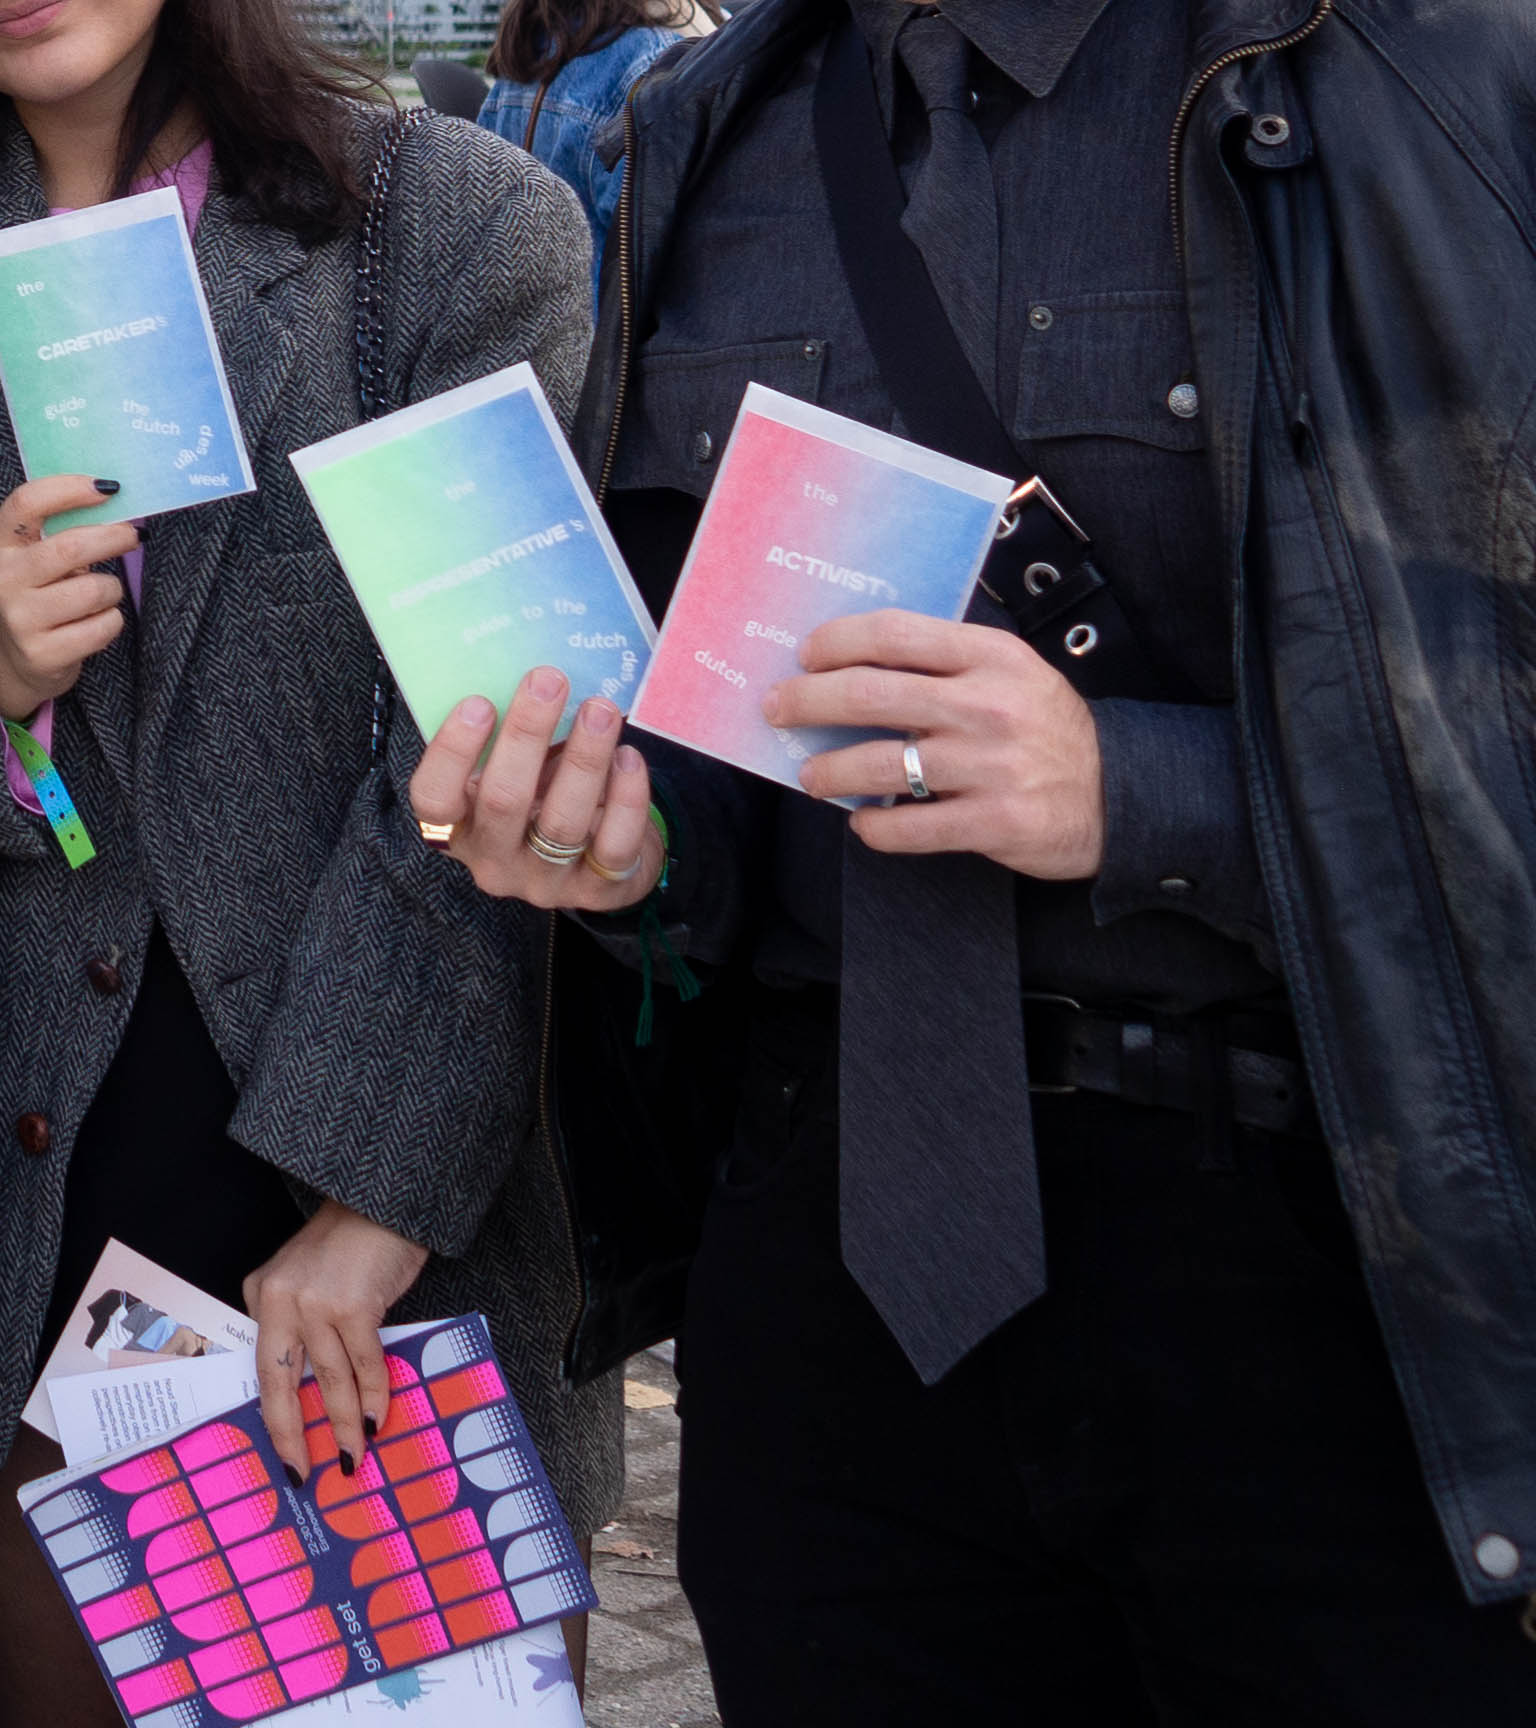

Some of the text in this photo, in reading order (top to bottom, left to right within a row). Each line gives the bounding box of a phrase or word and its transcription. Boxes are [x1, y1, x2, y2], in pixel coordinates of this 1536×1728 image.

[16, 279, 45, 297] the
[43, 396, 87, 421] guide
[121, 399, 151, 417] the
[62, 415, 80, 430] to
[131, 416, 181, 437] dutch
[188, 472, 230, 488] week
[444, 480, 477, 503] the
[803, 481, 838, 507] the
[521, 602, 544, 620] to
[554, 598, 587, 616] the
[568, 630, 628, 649] dutch
[744, 620, 798, 649] guide
[694, 648, 747, 689] dutch
[283, 1486, 306, 1524] October
[303, 1501, 330, 1553] Eindhoven
[337, 1600, 381, 1673] get set
